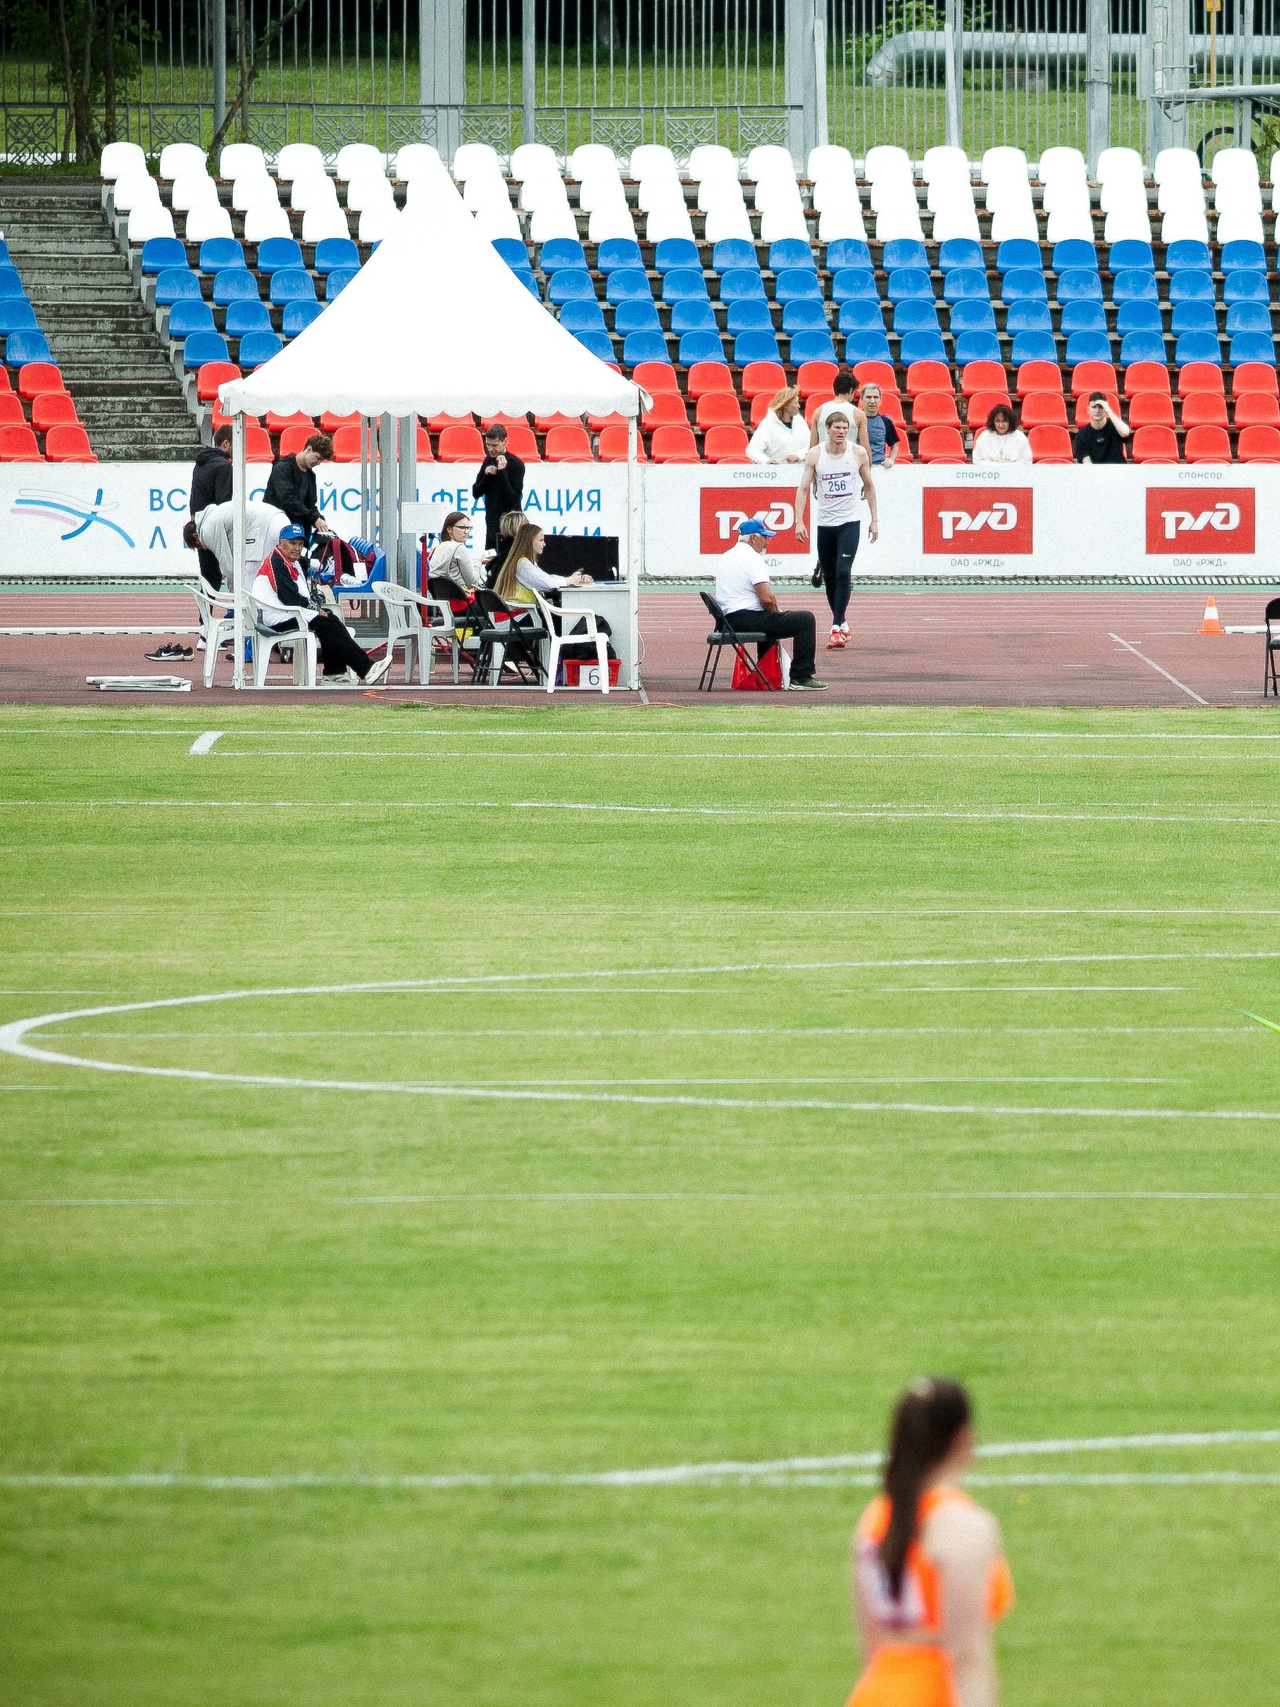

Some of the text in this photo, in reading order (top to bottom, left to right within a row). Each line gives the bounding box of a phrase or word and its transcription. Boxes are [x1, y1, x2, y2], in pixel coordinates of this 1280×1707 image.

[828, 480, 846, 492] 256
[938, 502, 1018, 540] РЖД
[1161, 502, 1240, 539] РЖД
[589, 668, 600, 686] 6
